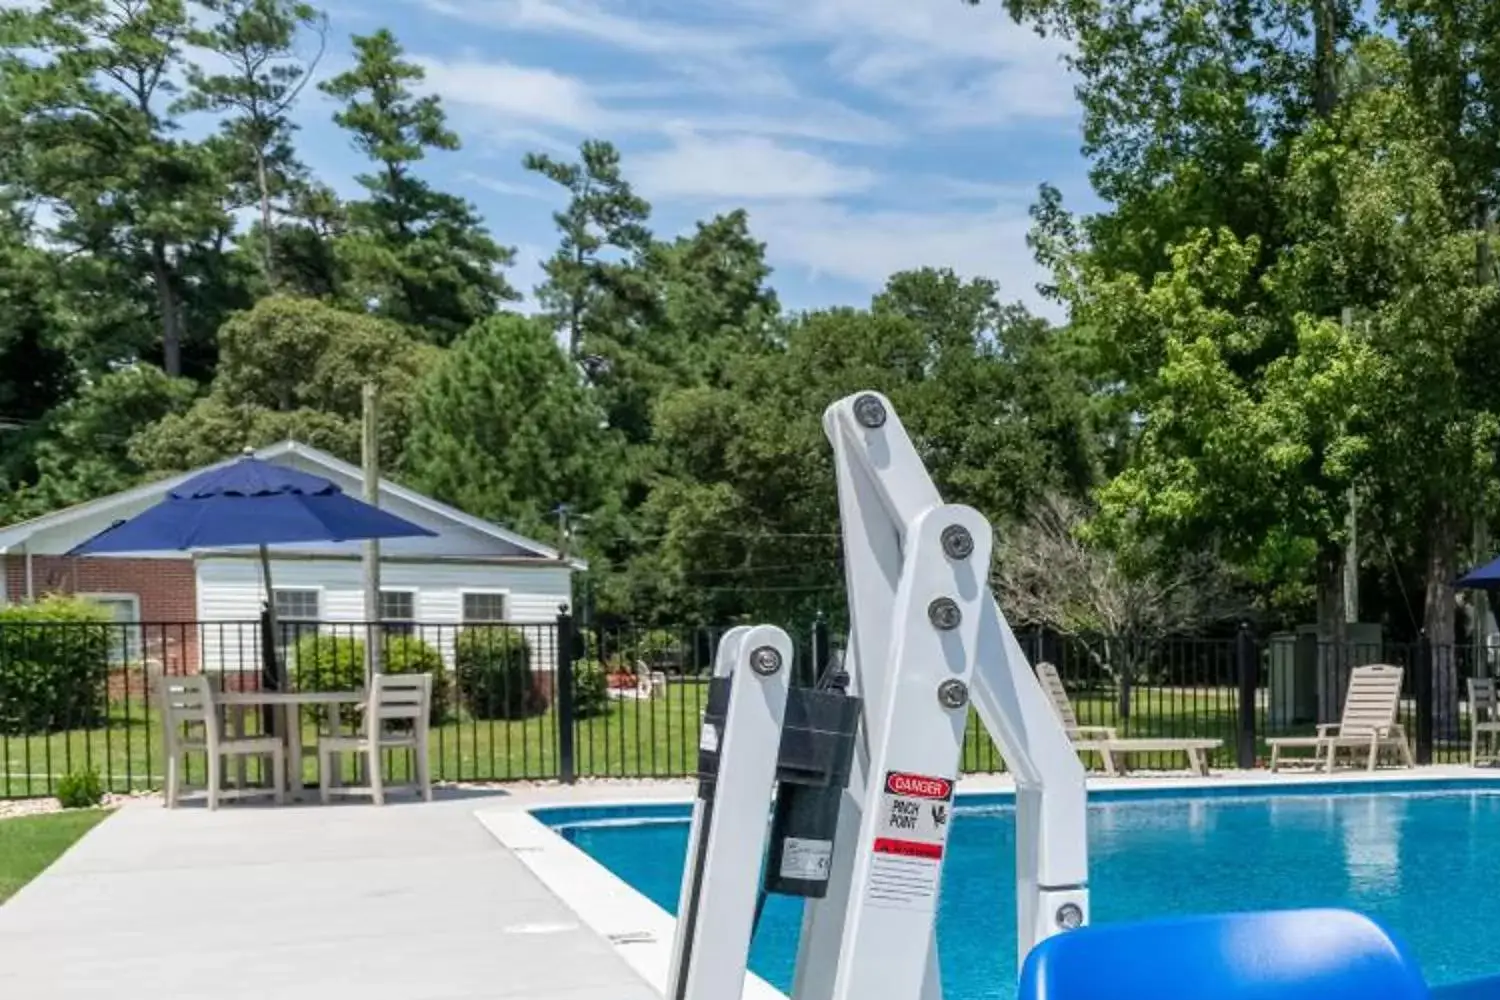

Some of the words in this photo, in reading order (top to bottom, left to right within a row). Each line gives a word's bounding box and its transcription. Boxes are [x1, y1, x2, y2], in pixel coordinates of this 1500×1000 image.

[895, 777, 941, 795] DANGER
[892, 800, 920, 815] PINCH
[889, 814, 917, 829] POINT
